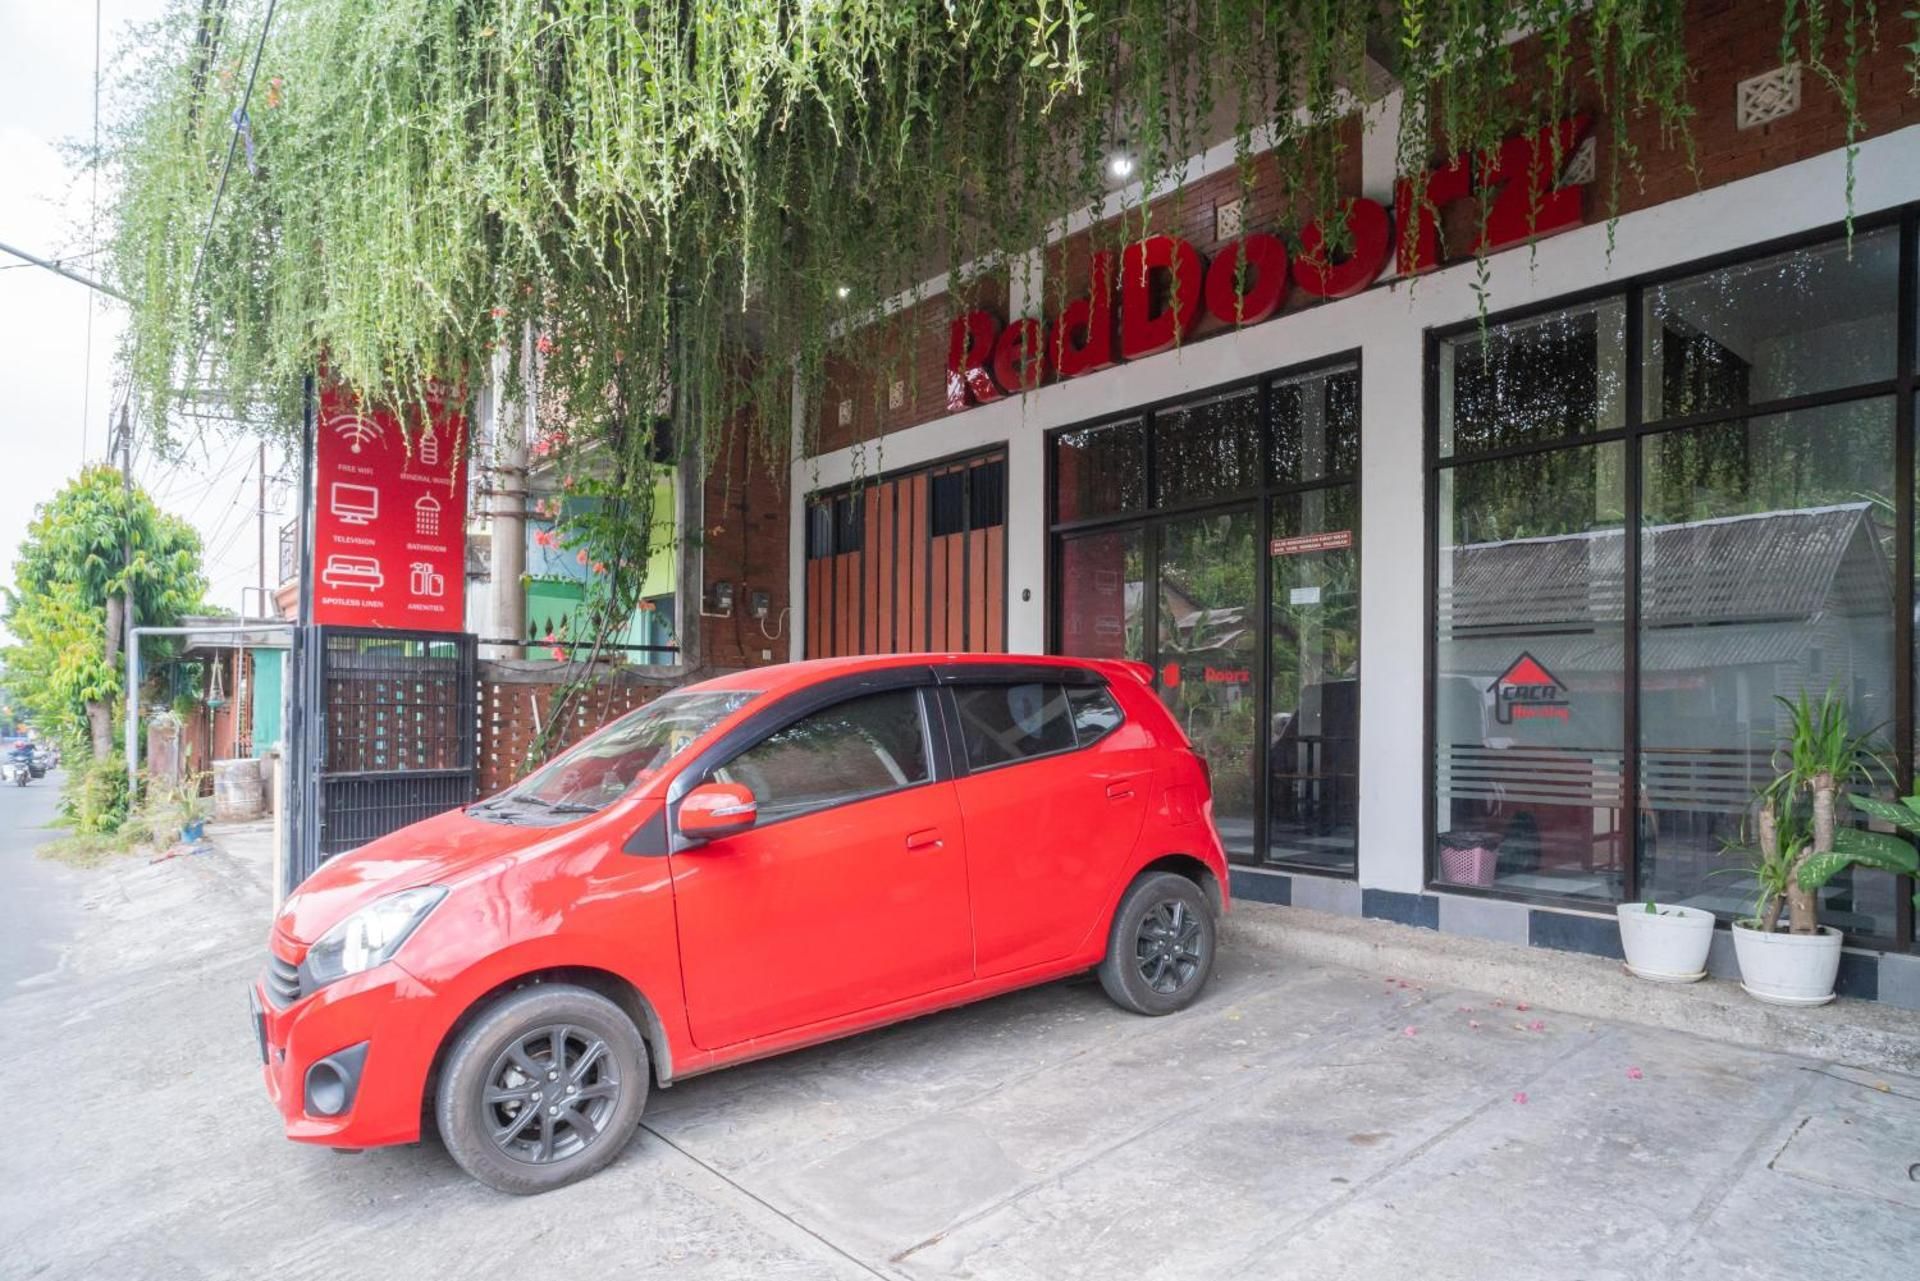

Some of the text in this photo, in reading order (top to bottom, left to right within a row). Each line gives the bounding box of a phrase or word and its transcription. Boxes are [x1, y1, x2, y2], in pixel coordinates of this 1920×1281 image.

[946, 112, 1592, 413] RedDoorz
[337, 463, 356, 473] FREE
[332, 535, 376, 546] TELEVISION
[406, 543, 447, 553] BATHROOM
[321, 597, 384, 608] SPOTLESS LINEN
